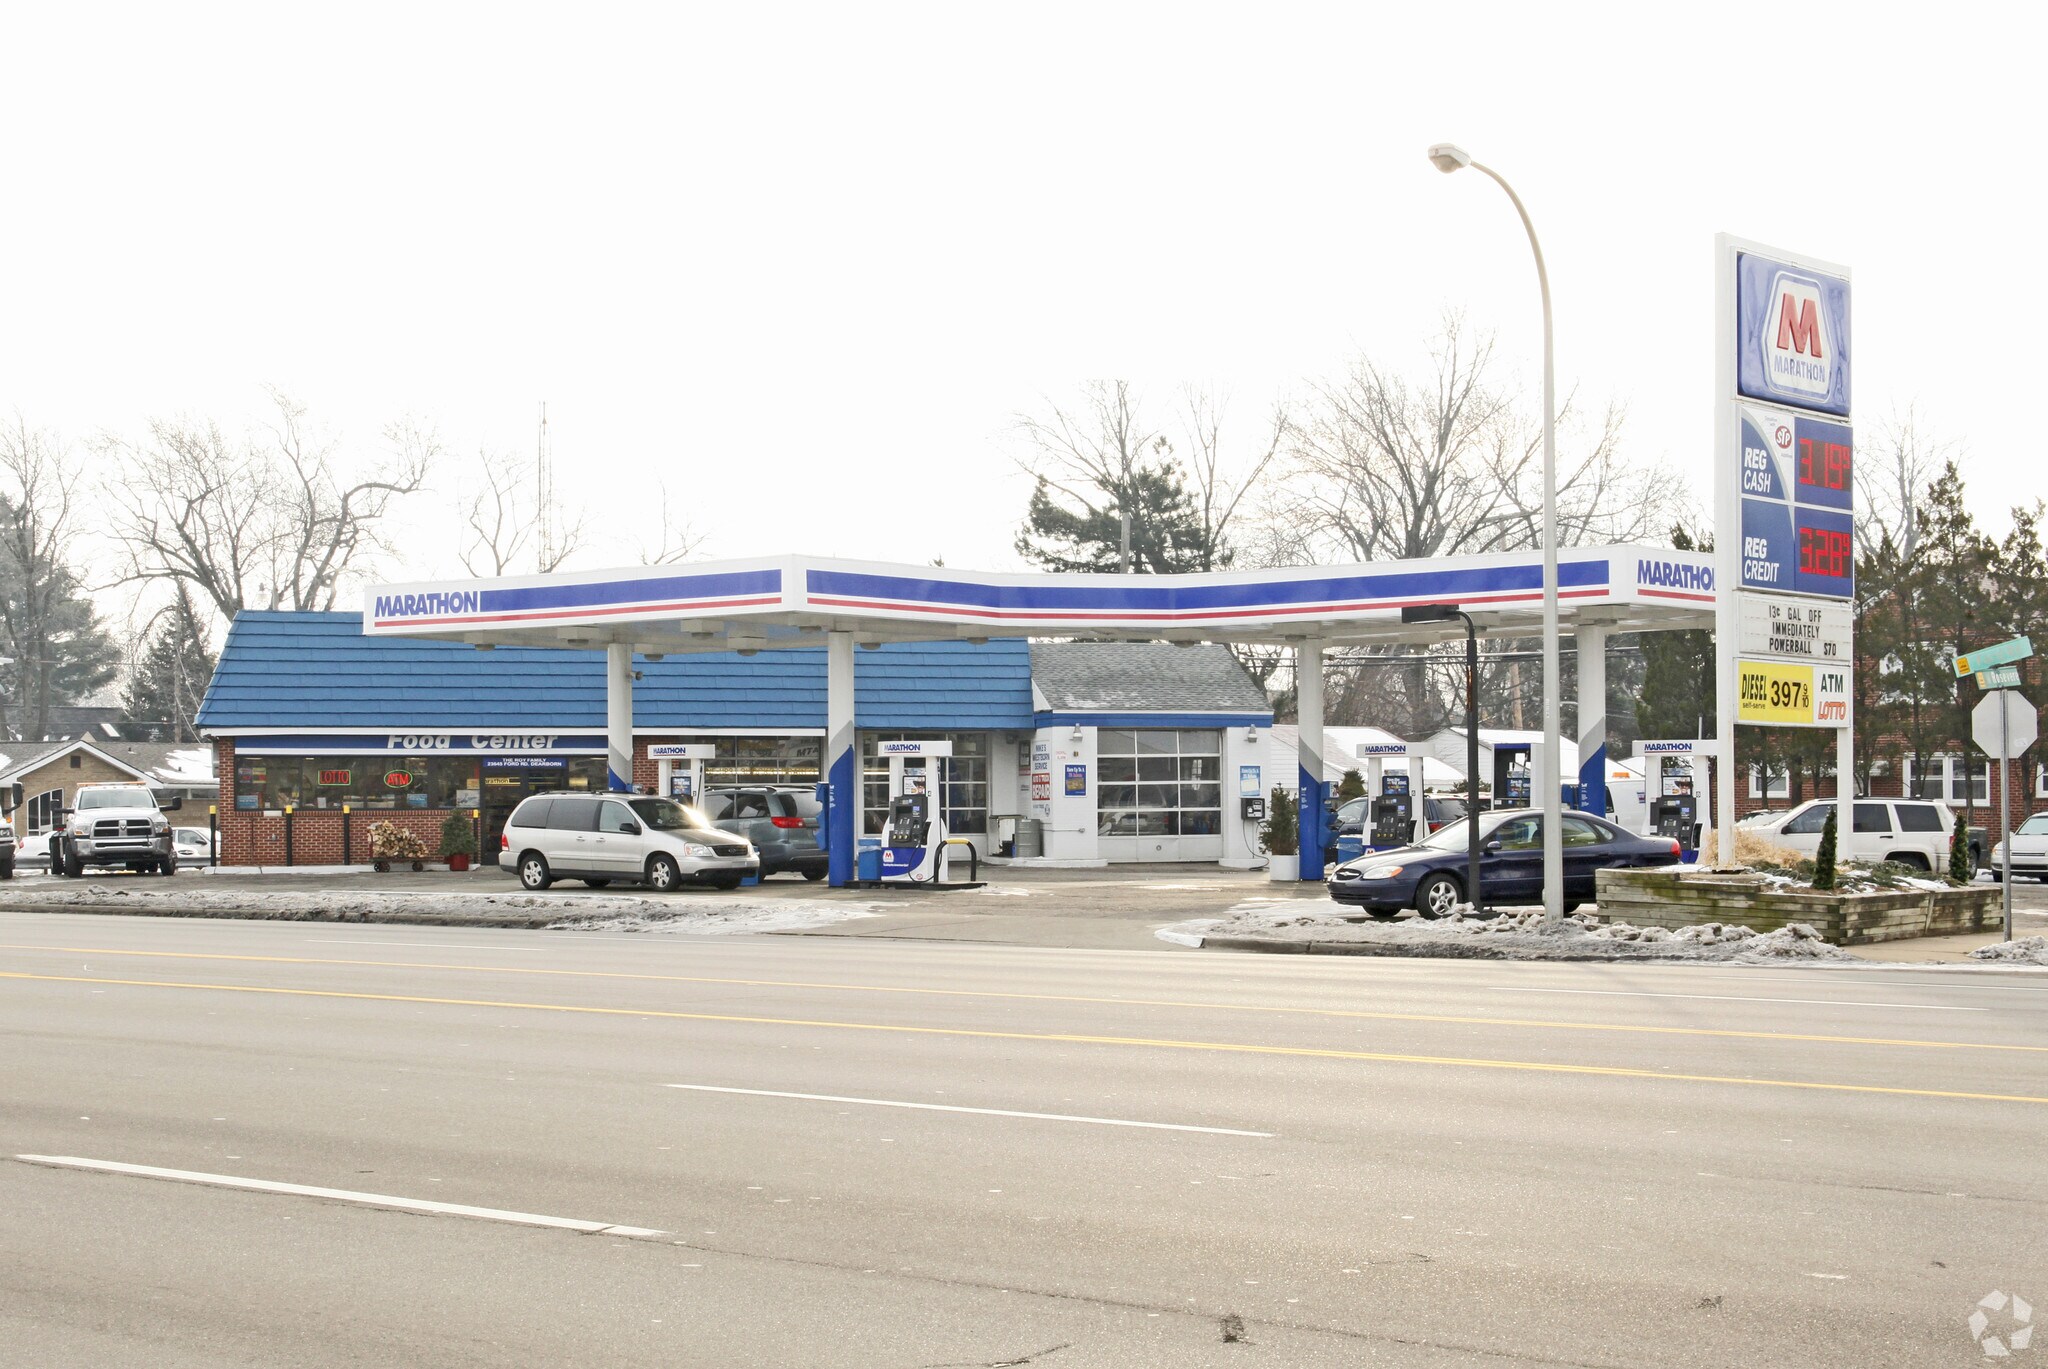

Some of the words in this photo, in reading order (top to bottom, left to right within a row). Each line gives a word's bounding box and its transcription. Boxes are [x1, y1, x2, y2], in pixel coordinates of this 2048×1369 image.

[1777, 293, 1822, 358] M
[1774, 355, 1825, 383] MARATHON
[1775, 428, 1791, 446] STP
[1744, 447, 1767, 470] REG
[1744, 470, 1771, 493] CASH
[1744, 537, 1767, 559] REG
[1637, 559, 1716, 592] MARATHO
[1744, 559, 1779, 583] CREDIT
[374, 590, 478, 617] MARATHON
[1787, 607, 1801, 621] GAL
[1808, 609, 1821, 622] OFF
[1772, 622, 1820, 639] IMMEDIATELY
[1769, 638, 1812, 654] POWERBALL
[1741, 674, 1767, 701] DIESEL
[1771, 680, 1801, 707] 397
[1820, 674, 1844, 693] ATM
[1818, 701, 1847, 720] LOTTO
[387, 735, 451, 749] Food
[471, 735, 558, 749] Center
[884, 743, 921, 751] MARATHON
[1365, 745, 1406, 753] MARATHON
[1645, 743, 1692, 751] MARATHON
[1034, 762, 1048, 770] SERVICE
[319, 770, 350, 785] LOTTO
[387, 773, 409, 785] ATM
[1032, 783, 1050, 800] REPAIR
